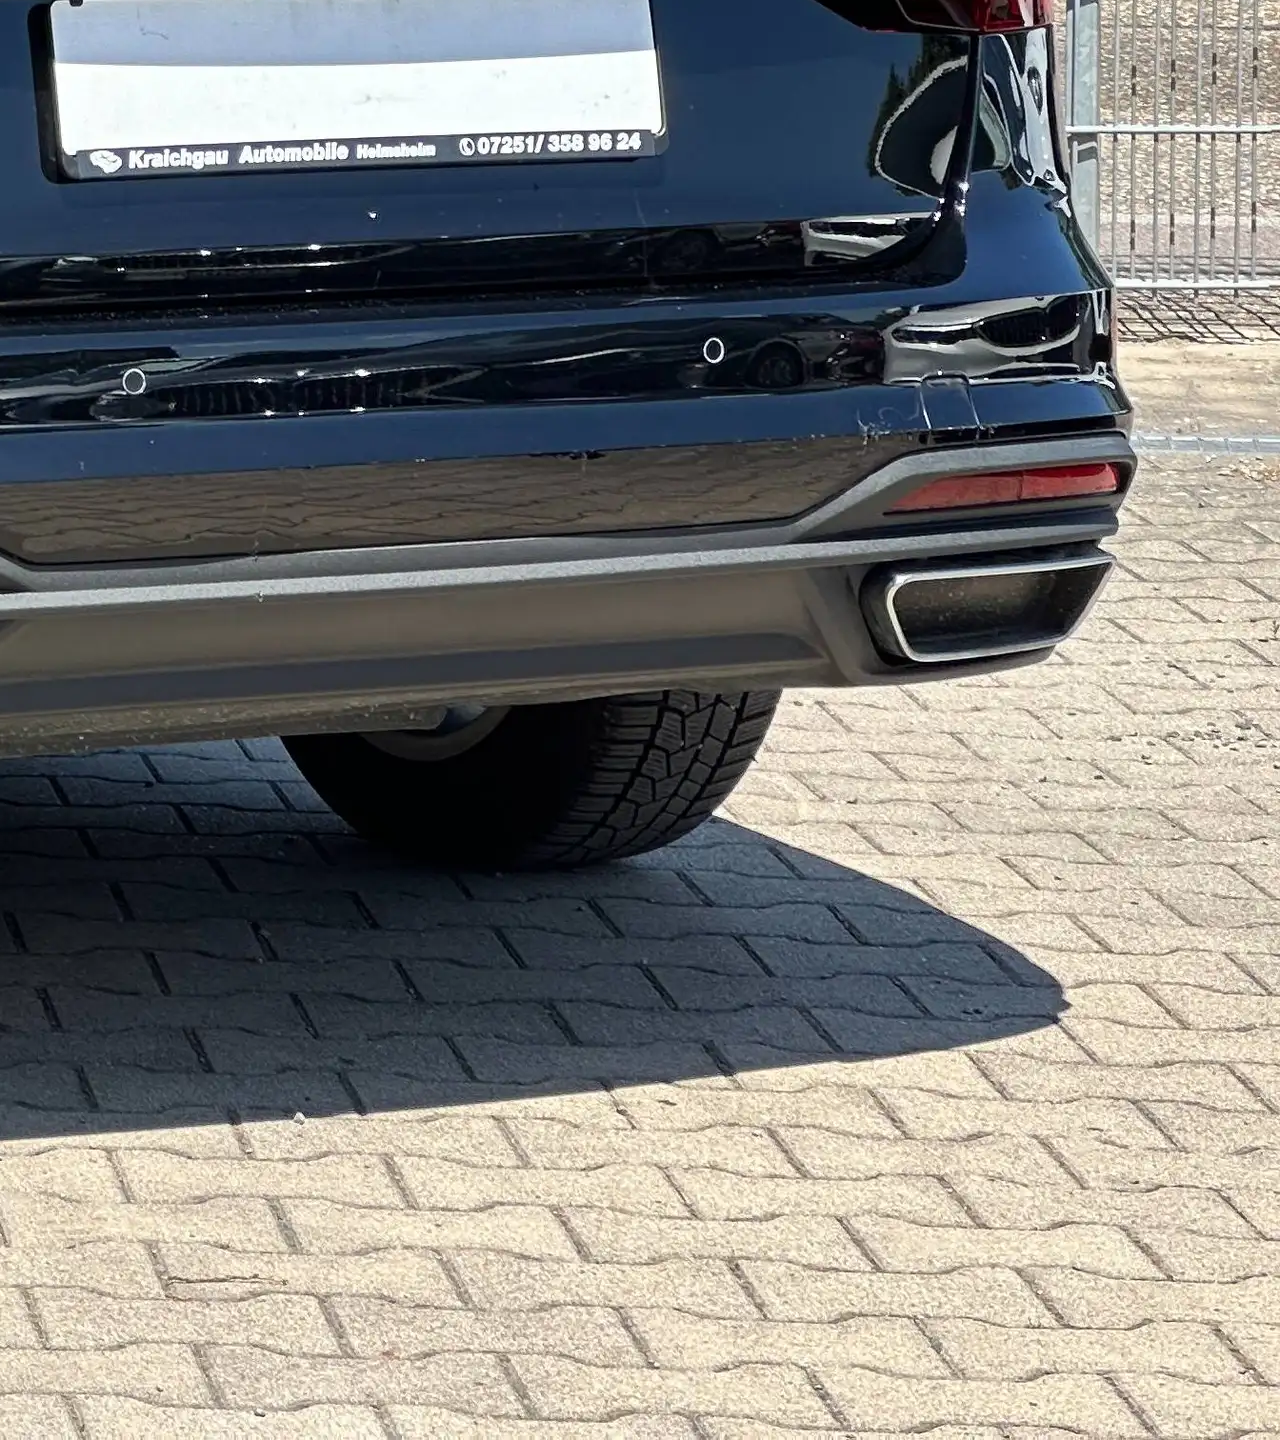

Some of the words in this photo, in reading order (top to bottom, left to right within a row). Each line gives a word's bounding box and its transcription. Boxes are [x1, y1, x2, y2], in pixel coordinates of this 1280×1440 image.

[128, 149, 229, 170] Kraichgau
[238, 142, 349, 165] Automobile
[477, 134, 545, 156] 07251/
[547, 133, 584, 153] 358
[588, 132, 613, 152] 96
[616, 131, 642, 151] 24
